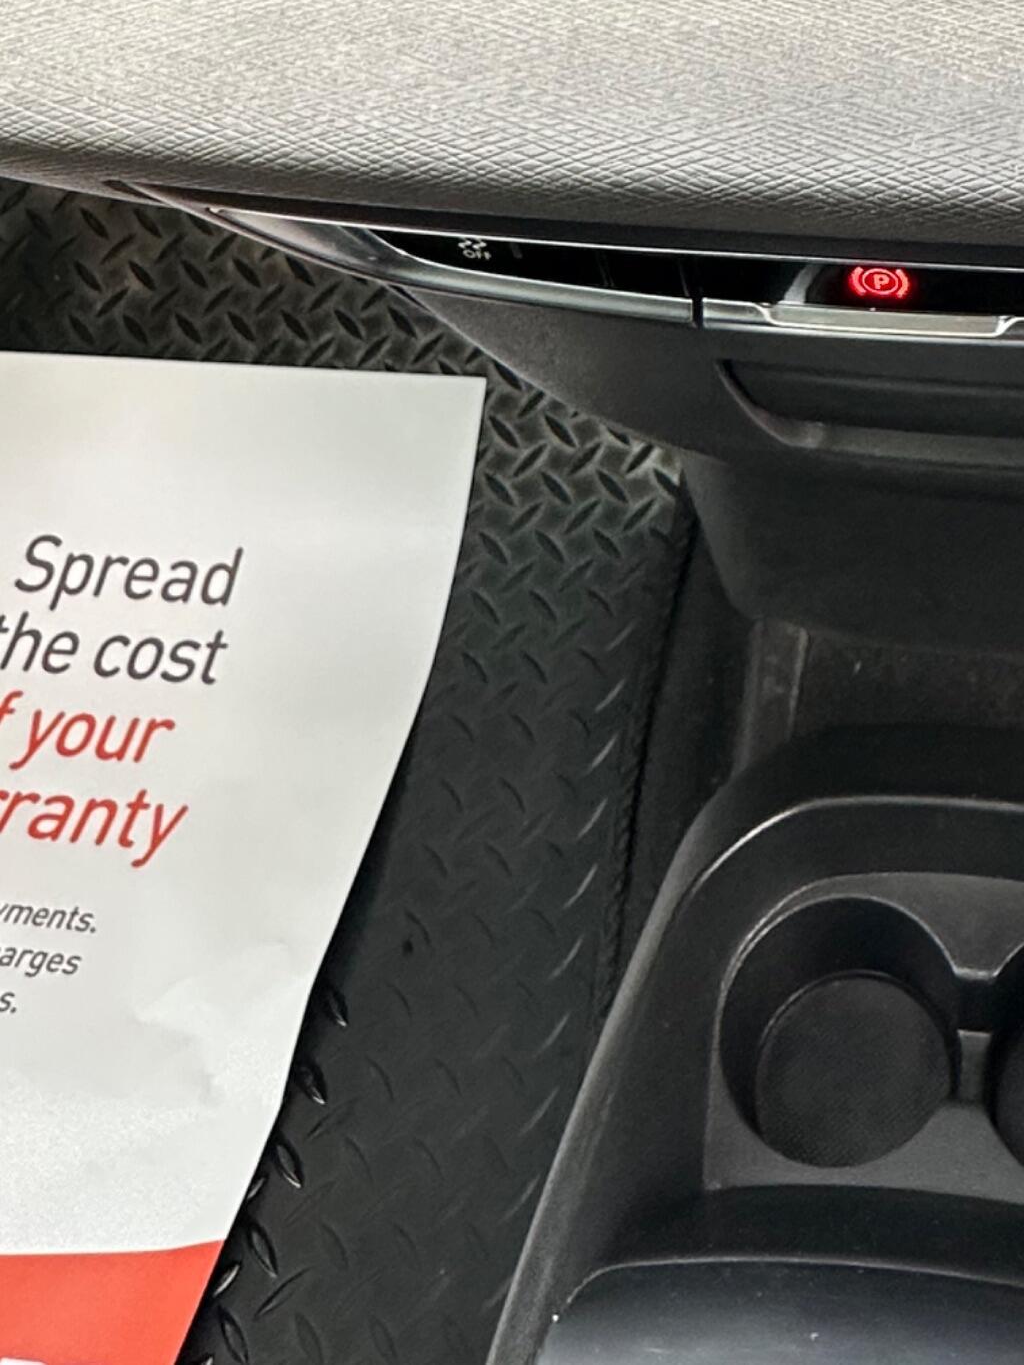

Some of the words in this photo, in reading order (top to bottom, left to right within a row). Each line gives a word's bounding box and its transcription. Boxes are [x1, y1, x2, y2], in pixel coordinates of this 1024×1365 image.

[13, 534, 244, 610] Spread
[93, 629, 229, 686] cost
[9, 708, 176, 770] your
